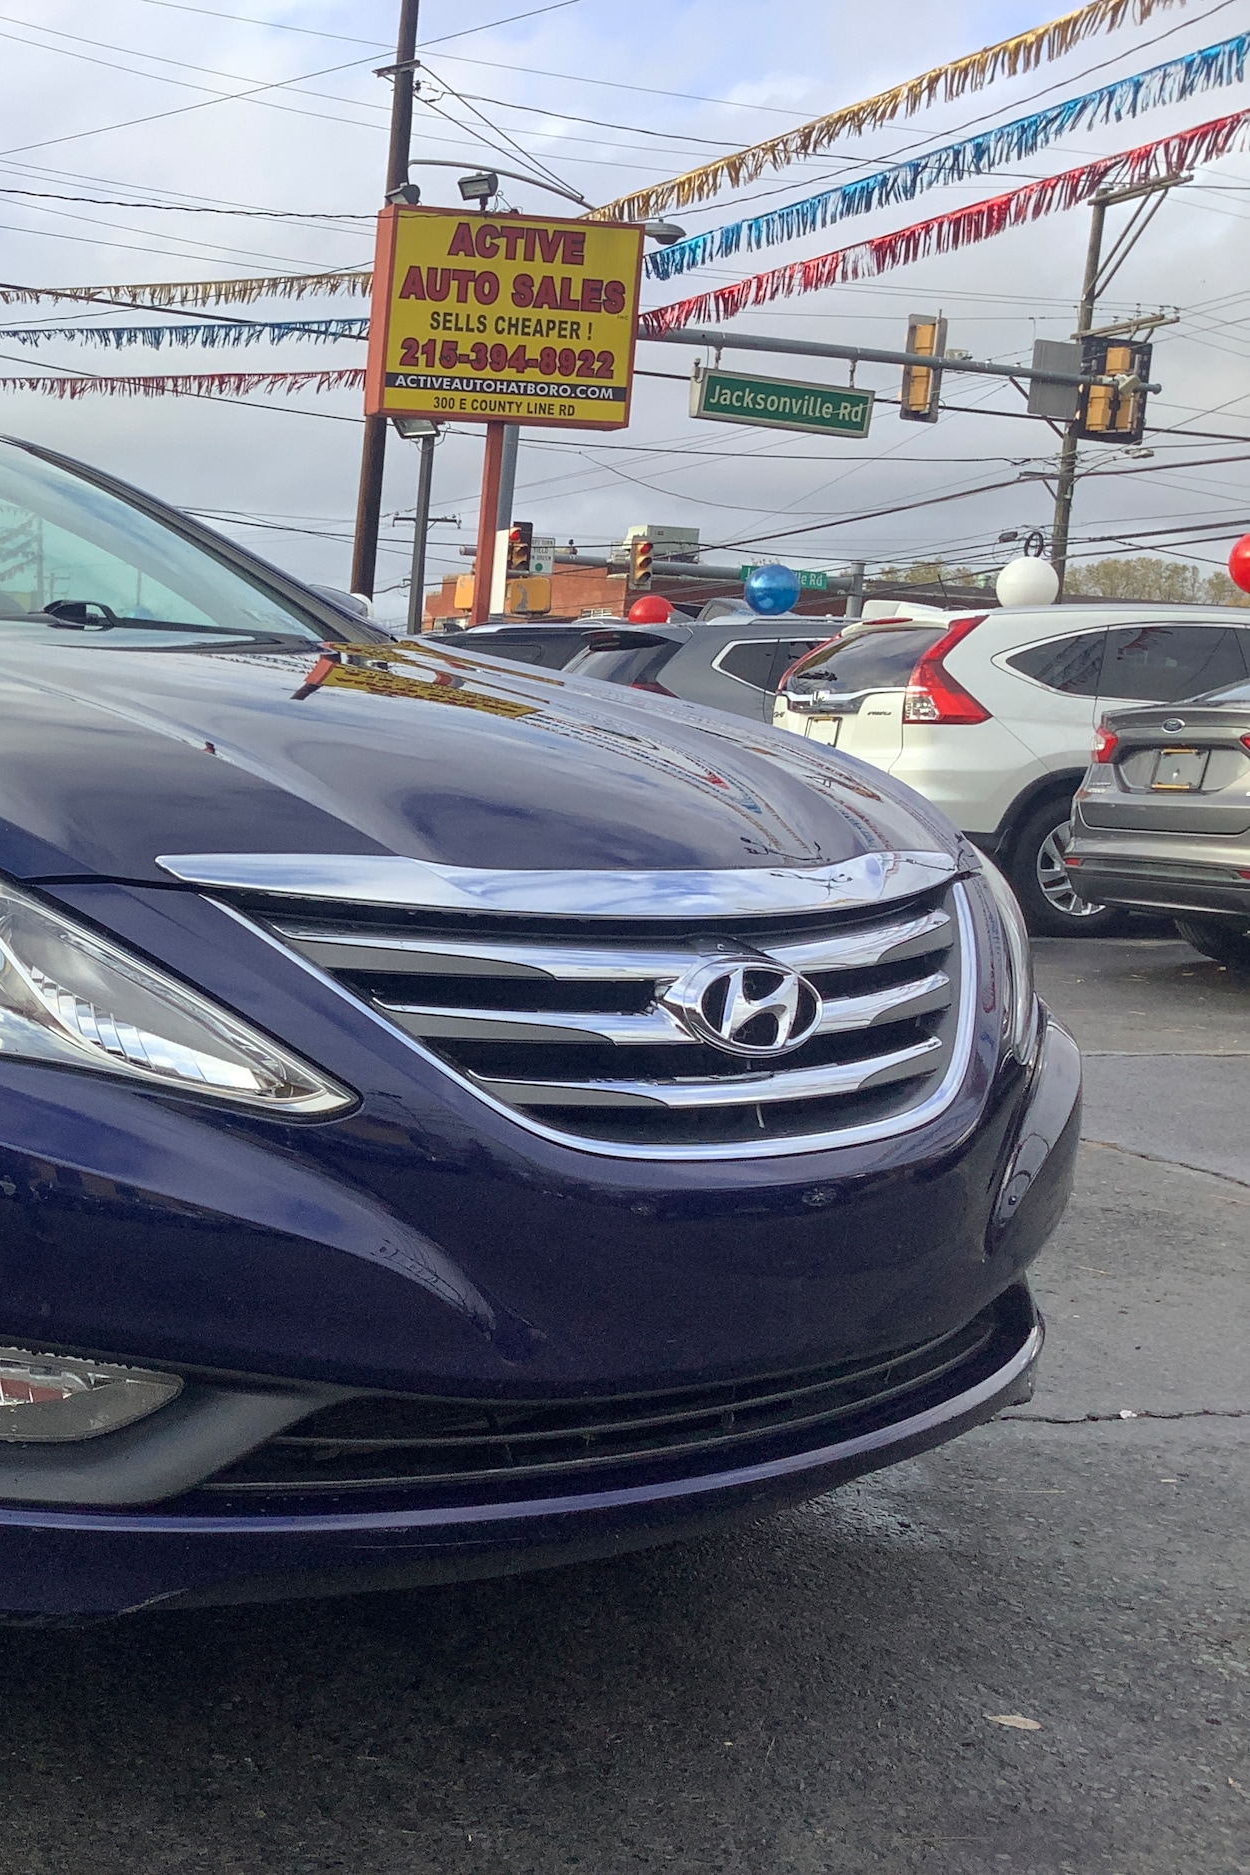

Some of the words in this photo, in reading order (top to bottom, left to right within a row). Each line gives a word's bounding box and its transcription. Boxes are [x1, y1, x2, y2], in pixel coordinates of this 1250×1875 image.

[447, 222, 586, 265] ACTIVE
[399, 266, 500, 305] AUTO
[511, 274, 626, 314] SALES
[430, 311, 487, 334] SELLS
[494, 316, 581, 340] CHEAPER
[399, 337, 614, 379] 215-394-8922
[395, 375, 613, 399] ACTIVEAUTOHATBORO.COM
[709, 385, 833, 418] Jacksonville
[838, 402, 863, 422] Rd
[433, 397, 455, 410] 300
[459, 398, 467, 410] E
[471, 399, 523, 414] COUNTY
[527, 401, 555, 415] LINE
[559, 403, 575, 417] RD
[810, 573, 823, 587] Rd
